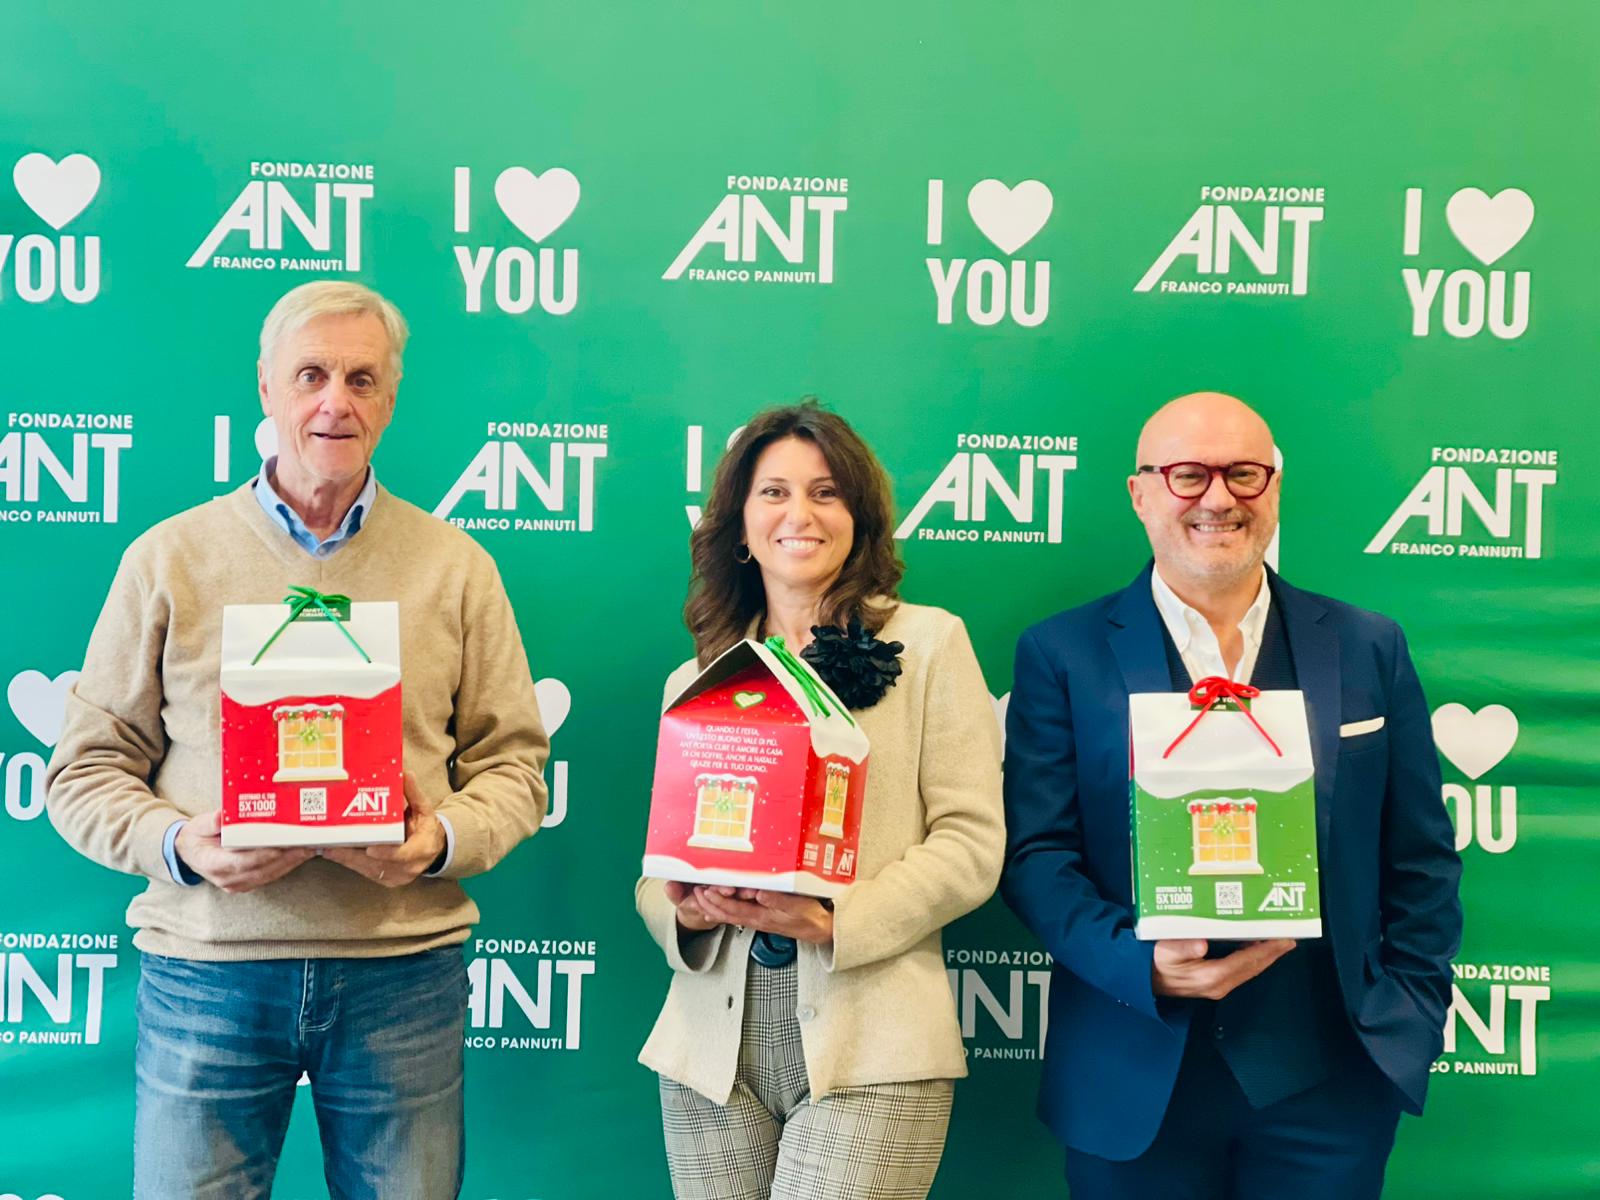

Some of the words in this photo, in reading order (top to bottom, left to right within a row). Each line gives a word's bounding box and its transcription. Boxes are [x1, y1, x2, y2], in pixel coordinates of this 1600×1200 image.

[251, 162, 375, 179] FONDAZIONE
[727, 175, 849, 193] FONDAZIONE
[455, 166, 471, 233] I
[1201, 186, 1325, 202] FONDAZIONE
[927, 179, 944, 245] I
[187, 181, 375, 271] ANT
[1403, 187, 1423, 256] I
[661, 194, 849, 284] ANT
[1133, 205, 1324, 296] ANT
[213, 256, 277, 270] FRANCO
[279, 258, 343, 271] PANNUTI
[454, 245, 579, 315] YOU
[688, 268, 751, 281] FRANCO
[754, 270, 816, 283] PANNUTI
[925, 257, 1051, 328] YOU
[1160, 280, 1223, 293] FRANCO
[1226, 282, 1290, 295] PANNUTI
[1402, 268, 1531, 340] YOU
[8, 413, 133, 429] FONDAZIONE
[487, 422, 608, 438] FONDAZIONE
[213, 415, 230, 482] I
[957, 433, 1078, 451] FONDAZIONE
[686, 425, 703, 492] I
[1431, 447, 1557, 466] FONDAZIONE
[431, 440, 608, 532] ANT
[892, 452, 1078, 544] ANT
[0, 510, 33, 522] NCO
[36, 510, 101, 523] PANNUTI
[1363, 466, 1557, 559] ANT
[513, 518, 576, 532] PANNUTI
[918, 528, 980, 542] FRANCO
[982, 530, 1046, 543] PANNUTI
[1391, 542, 1455, 556] FRANCO
[1459, 544, 1523, 558] PANNUTI
[238, 800, 277, 812] 5X1000
[341, 791, 390, 817] ANT
[1441, 783, 1518, 854] OU
[1156, 893, 1193, 905] 5X1000
[1258, 886, 1306, 913] ANT
[0, 933, 119, 949] ONDAZIONE
[474, 938, 597, 955] FONDAZIONE
[946, 949, 1054, 966] FONDAZION
[1451, 963, 1551, 982] NDAZIONE
[0, 952, 118, 1045] NT
[946, 968, 1052, 1060] NT
[18, 1031, 82, 1045] PANNUTI
[1442, 983, 1552, 1076] NT
[464, 1036, 496, 1049] NCO
[500, 1037, 563, 1050] PANNUTI
[974, 1047, 1035, 1060] PANNUTI
[1454, 1061, 1519, 1075] PANNUTI
